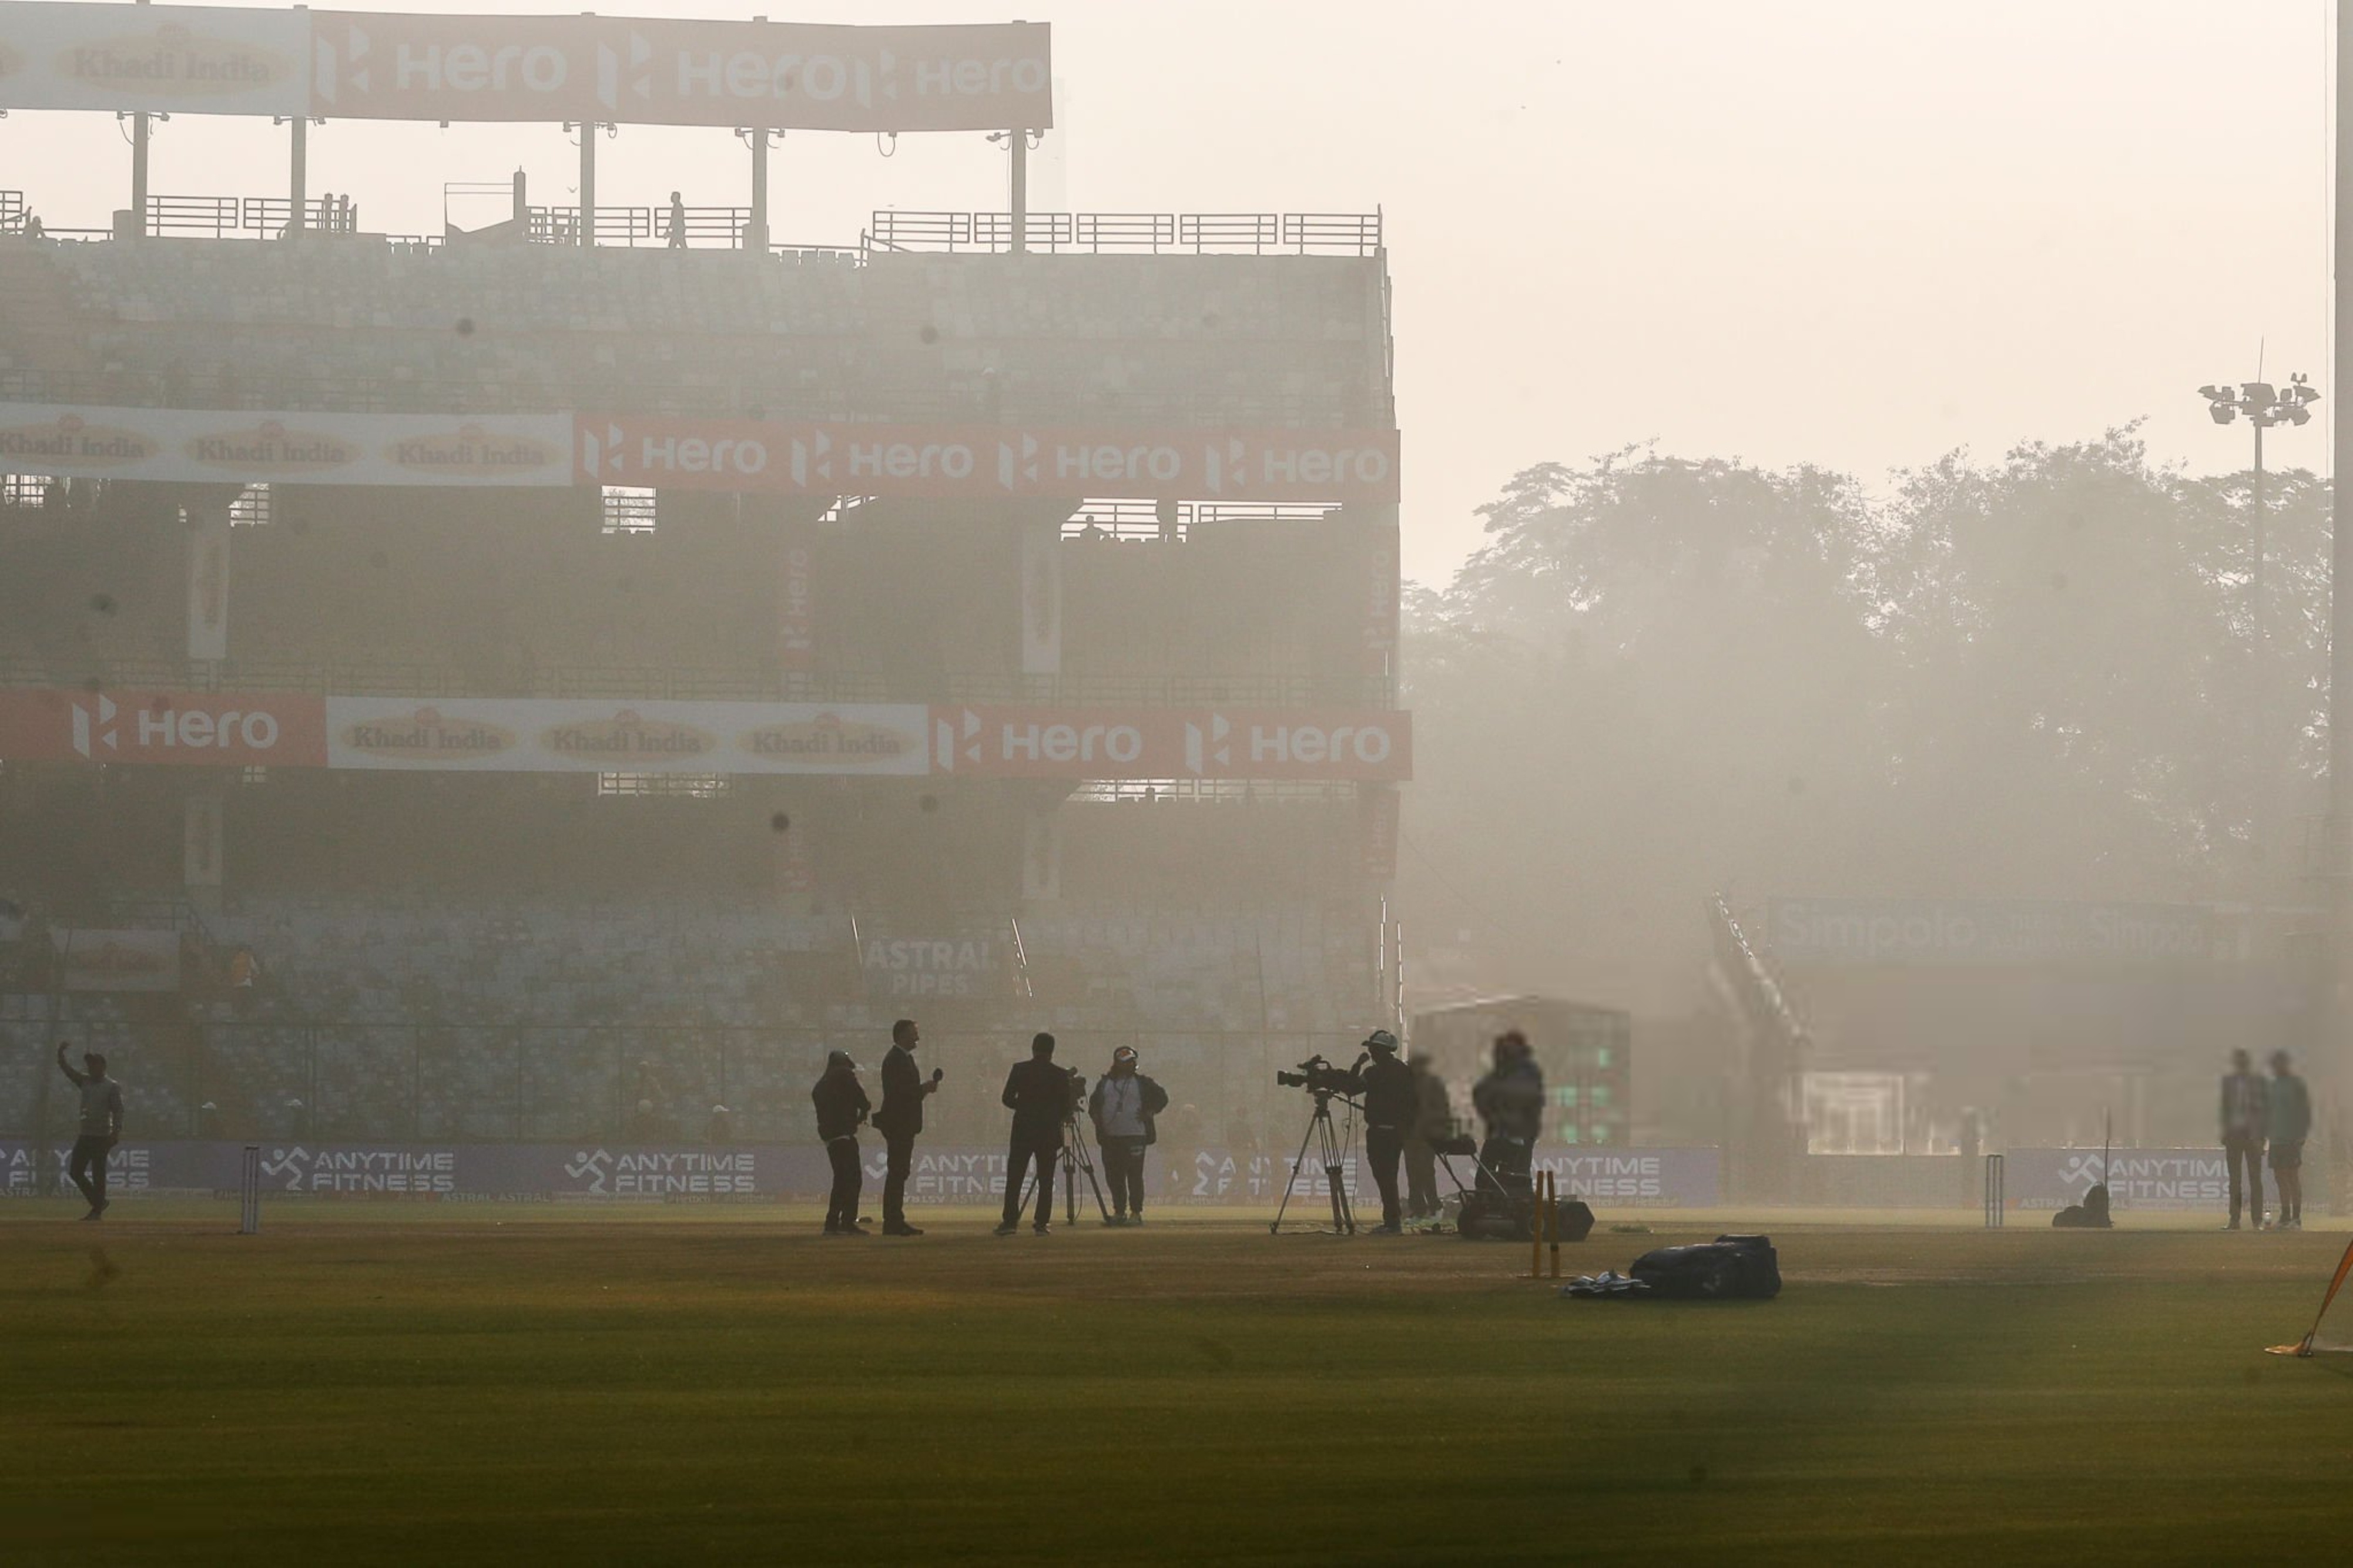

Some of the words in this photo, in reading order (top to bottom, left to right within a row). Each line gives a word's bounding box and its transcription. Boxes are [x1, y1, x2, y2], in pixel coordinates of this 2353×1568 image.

[73, 47, 174, 79] Khadi
[185, 48, 270, 82] India
[396, 43, 567, 92] Hero
[678, 50, 847, 100] Hero
[914, 56, 1045, 96] Hero
[82, 436, 145, 458] India
[196, 438, 274, 462] Khadi
[283, 441, 345, 463] India
[397, 441, 474, 464] Khadi
[482, 442, 545, 465] India
[642, 436, 766, 474] Hero
[850, 442, 973, 479] Hero
[1057, 445, 1181, 481] Hero
[1265, 448, 1389, 484] Hero
[138, 709, 279, 748] Hero
[354, 726, 428, 748] Khadi
[438, 727, 501, 750] India
[554, 729, 629, 753] Khadi
[637, 730, 702, 753] India
[752, 731, 829, 753] Khadi
[837, 733, 900, 754] India
[1001, 724, 1142, 762] Hero
[1251, 725, 1392, 763] Hero
[864, 940, 999, 969] ASTRAL
[892, 973, 969, 995] PIPES
[314, 1151, 454, 1170] ANYTIME
[616, 1153, 755, 1171] ANYTIME
[917, 1154, 1037, 1173] ANYTI
[312, 1174, 455, 1191] FITNESS
[615, 1176, 755, 1193] FITNESS
[1532, 1178, 1661, 1196] ITNESS
